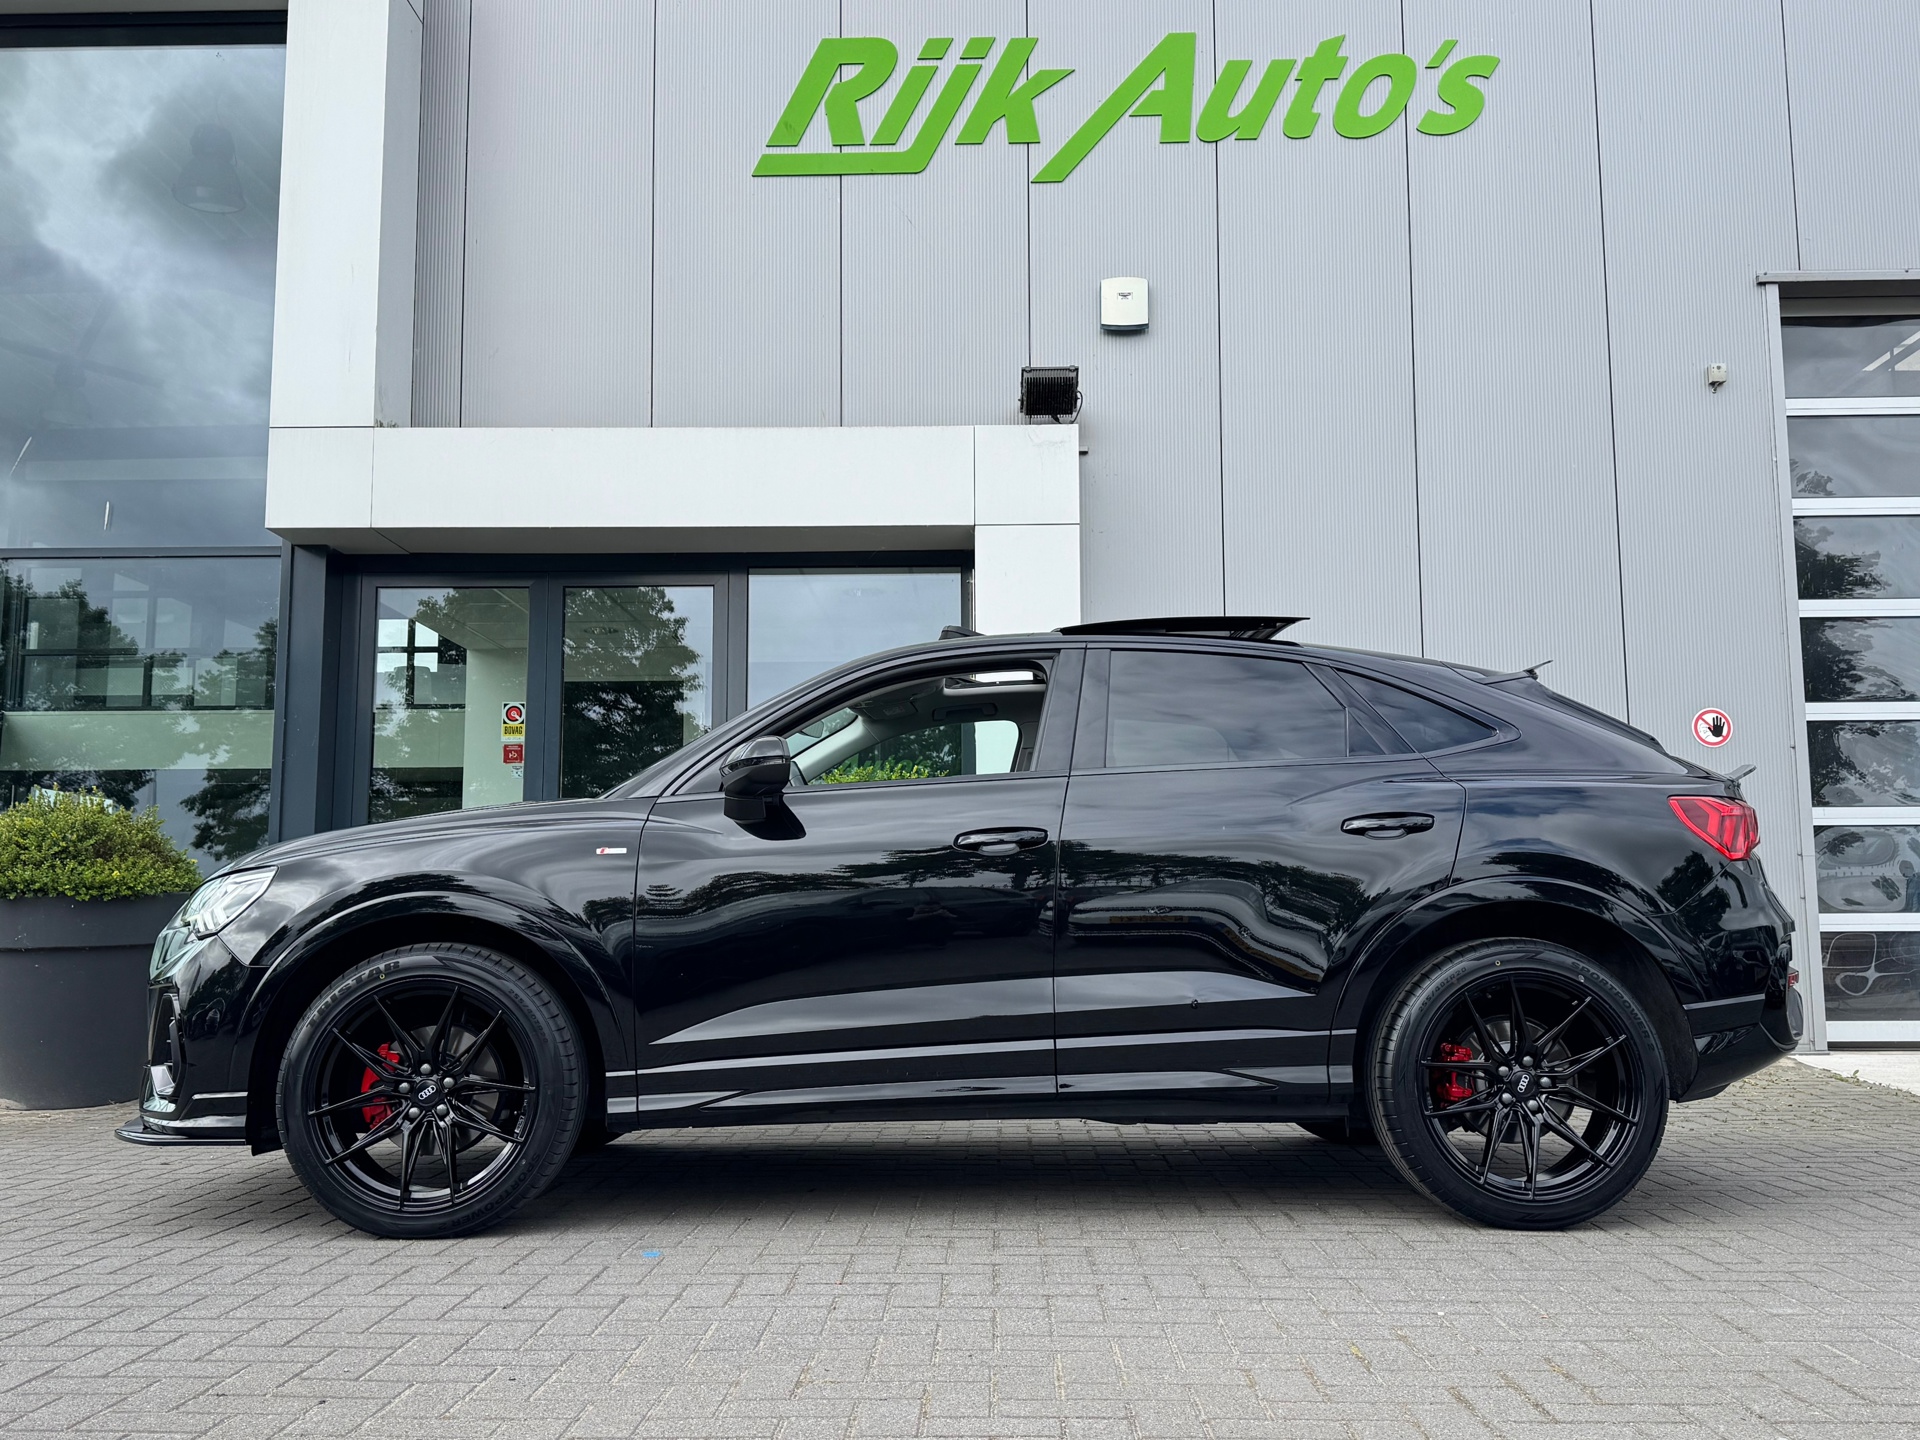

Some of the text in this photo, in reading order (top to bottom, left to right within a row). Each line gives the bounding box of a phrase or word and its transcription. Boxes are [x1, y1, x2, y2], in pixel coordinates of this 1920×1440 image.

[752, 32, 1501, 184] Rijk Auto's
[504, 725, 523, 735] BOVAG
[305, 960, 401, 1029] TRISTAR
[1571, 961, 1651, 1040] SPORTPOWER
[451, 1152, 541, 1228] SPORTPOWER
